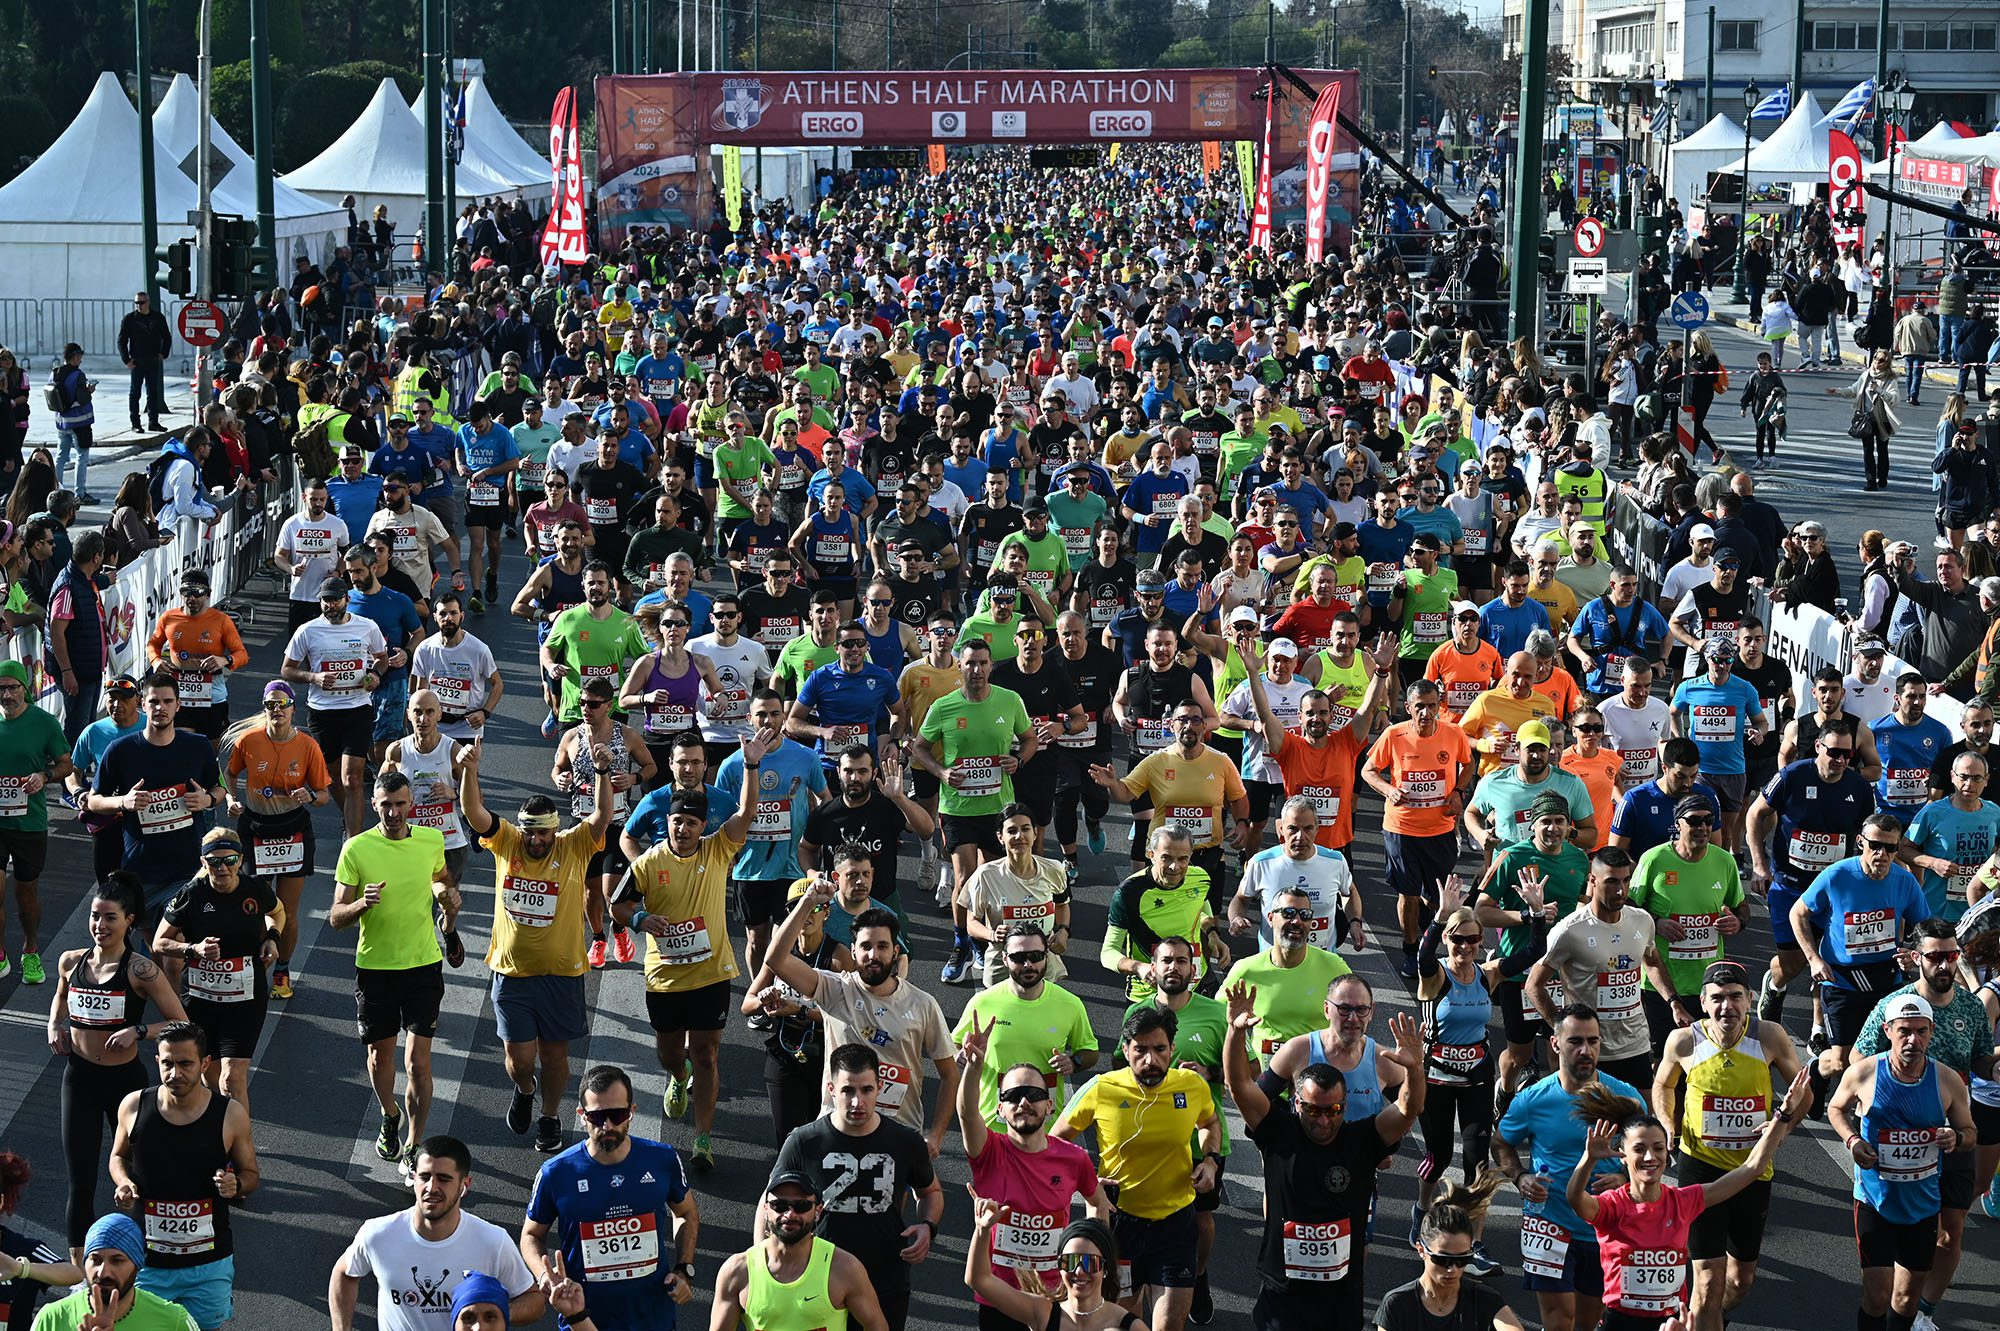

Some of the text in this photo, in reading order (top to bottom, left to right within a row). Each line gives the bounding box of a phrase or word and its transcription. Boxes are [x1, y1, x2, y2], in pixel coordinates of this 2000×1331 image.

[722, 79, 760, 88] SEGAS
[783, 80, 1175, 105] ATHENS HALF MARATHON
[640, 117, 663, 125] HALF
[806, 117, 858, 132] ERGO
[1094, 116, 1146, 132] ERGO
[633, 166, 660, 177] 2024
[474, 487, 495, 496] 10304
[1571, 485, 1588, 496] 56
[590, 499, 609, 507] ERGO
[592, 507, 610, 515] 3020
[301, 530, 325, 538] ERGO
[1064, 528, 1086, 536] ERGO
[303, 539, 323, 547] 4416
[394, 537, 408, 545] 417
[823, 535, 844, 543] ERGO
[823, 543, 842, 551] 3581
[1025, 571, 1048, 579] ERGO
[1096, 599, 1118, 607] ERGO
[768, 617, 792, 626] ERGO
[1420, 613, 1442, 621] ERGO
[769, 627, 792, 636] 4003
[1421, 622, 1441, 630] 3235
[1712, 622, 1735, 631] ERGO
[1712, 631, 1733, 639] 4498
[1315, 638, 1332, 646] ERG
[328, 661, 356, 671] ERGO
[587, 666, 612, 676] ERGO
[1614, 664, 1626, 673] 39
[178, 672, 204, 683] ERGO
[336, 672, 355, 681] 465
[179, 682, 203, 692] 5509
[437, 677, 464, 689] ERGO
[1454, 682, 1480, 691] ERGO
[436, 688, 460, 699] 4332
[1455, 691, 1478, 700] 4150
[659, 705, 685, 714] ERGO
[1700, 706, 1727, 716] ERGO
[659, 715, 683, 724] 3691
[1701, 717, 1727, 727] 4494
[1144, 730, 1162, 740] 446
[1624, 749, 1651, 760] ERGO
[963, 757, 993, 768] ERGO
[1625, 760, 1650, 770] 3407
[966, 768, 992, 779] 4880
[1408, 770, 1437, 781] ERGO
[1894, 768, 1922, 779] ERGO
[1410, 782, 1437, 793] 4605
[1896, 779, 1921, 790] 3547
[1302, 786, 1331, 797] ERGO
[149, 800, 179, 815] 4646
[415, 805, 444, 817] ERGO
[1173, 807, 1203, 818] ERGO
[417, 816, 444, 827] 4490
[1175, 818, 1202, 828] 3994
[262, 834, 294, 844] ERGO
[1800, 832, 1831, 843] ERGO
[1956, 832, 1989, 841] IF YOU
[1799, 844, 1828, 855] 4719
[1956, 839, 1989, 851] RUN
[264, 845, 292, 857] 3267
[1973, 850, 1989, 858] MUST
[512, 878, 549, 894] ERGO
[1958, 876, 1971, 886] 39
[512, 892, 545, 907] 4108
[1013, 905, 1047, 918] ERGO
[1852, 910, 1884, 923] ERGO
[1679, 915, 1711, 927] ERGO
[664, 920, 697, 936] ERGO
[1855, 922, 1884, 936] 4470
[1685, 928, 1709, 940] 368
[665, 934, 696, 950] 4057
[199, 960, 233, 972] ERGO
[200, 971, 232, 984] 3375
[1607, 971, 1637, 985] ERGO
[1609, 985, 1636, 1000] 3386
[77, 995, 111, 1011] 3925
[1441, 1046, 1477, 1059] ERGO
[1713, 1098, 1756, 1111] ERGO
[1716, 1115, 1753, 1128] 1706
[1889, 1131, 1930, 1144] ERGO
[1892, 1146, 1929, 1160] 4427
[822, 1152, 895, 1214] 23
[156, 1202, 201, 1216] ERGO
[1010, 1211, 1054, 1229] ERGO
[158, 1220, 198, 1234] 4246
[593, 1218, 642, 1237] ERGO
[1295, 1223, 1339, 1240] ERGO
[1522, 1216, 1559, 1236] ERGO
[1010, 1229, 1050, 1247] 3592
[1522, 1232, 1552, 1251] 3770
[598, 1236, 642, 1254] 3612
[1298, 1242, 1337, 1257] 5951
[1633, 1250, 1678, 1266] ERGO
[1636, 1268, 1675, 1285] 3768
